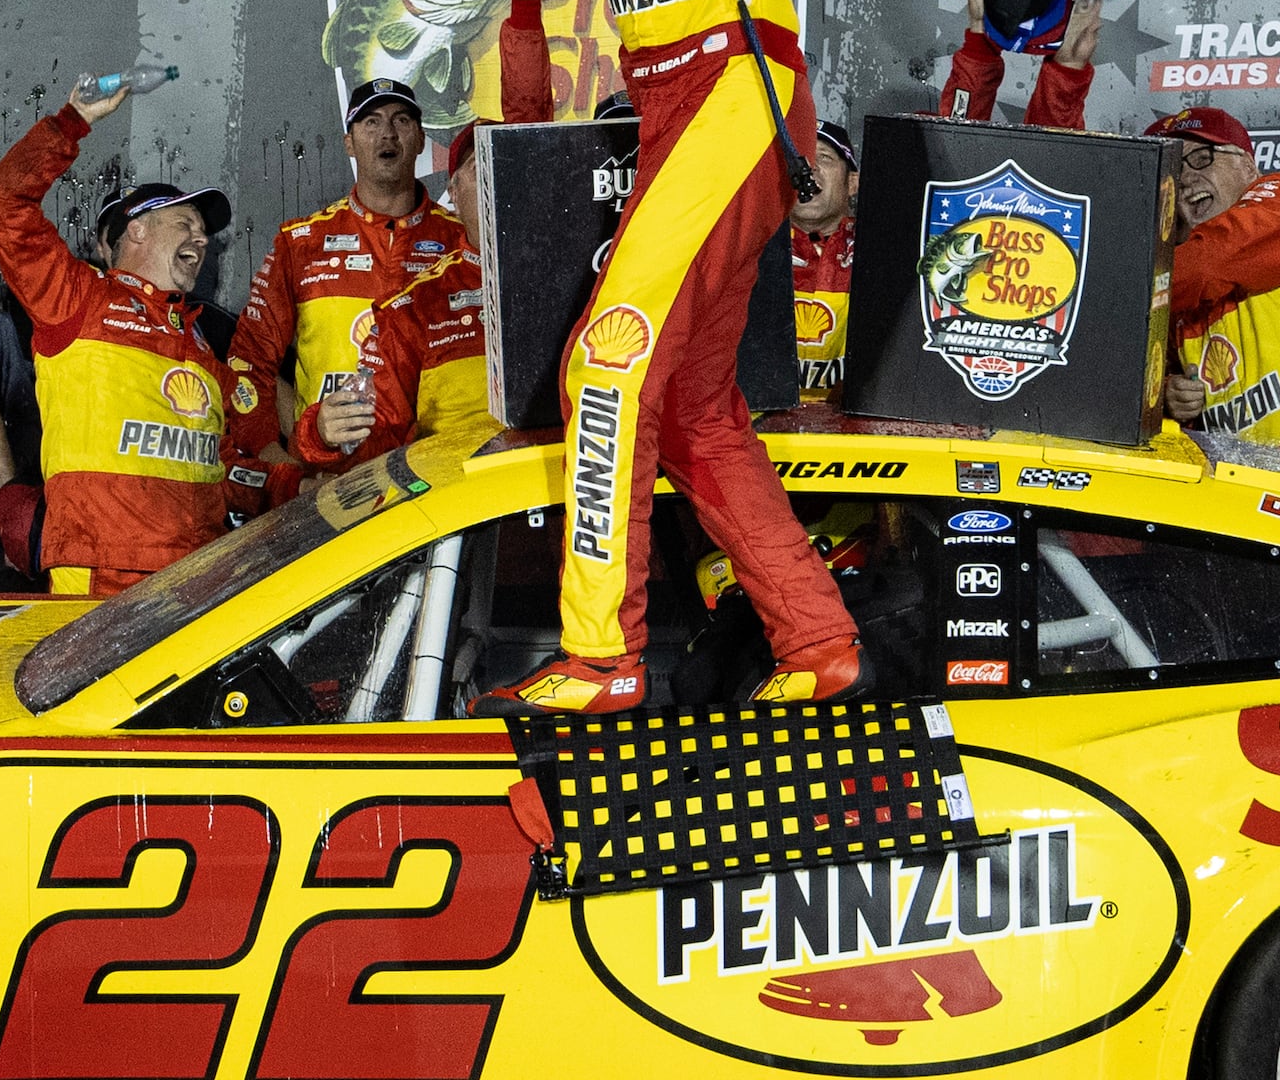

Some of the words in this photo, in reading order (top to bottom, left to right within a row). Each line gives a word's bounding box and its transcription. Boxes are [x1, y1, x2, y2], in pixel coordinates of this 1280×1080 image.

[1161, 62, 1269, 88] BOATS
[983, 221, 1046, 253] Bass
[985, 249, 1030, 277] Pro
[982, 275, 1058, 314] Shops
[945, 319, 1050, 341] AMERICA'S
[943, 333, 1000, 349] NIGHT
[1001, 339, 1047, 354] RACE
[948, 346, 977, 355] BRISTOL
[978, 349, 1004, 358] MOTOR
[1005, 352, 1043, 361] SPEEDWAY
[119, 419, 220, 465] PENNZO
[573, 384, 623, 562] PENNZOIL
[771, 461, 908, 479] OGANO
[943, 535, 1016, 545] RACING
[959, 566, 998, 593] PPG
[946, 620, 1010, 638] Mazak
[948, 662, 1007, 683] Coca-Cola
[609, 677, 638, 695] 22
[657, 822, 1102, 985] PENNZOIL
